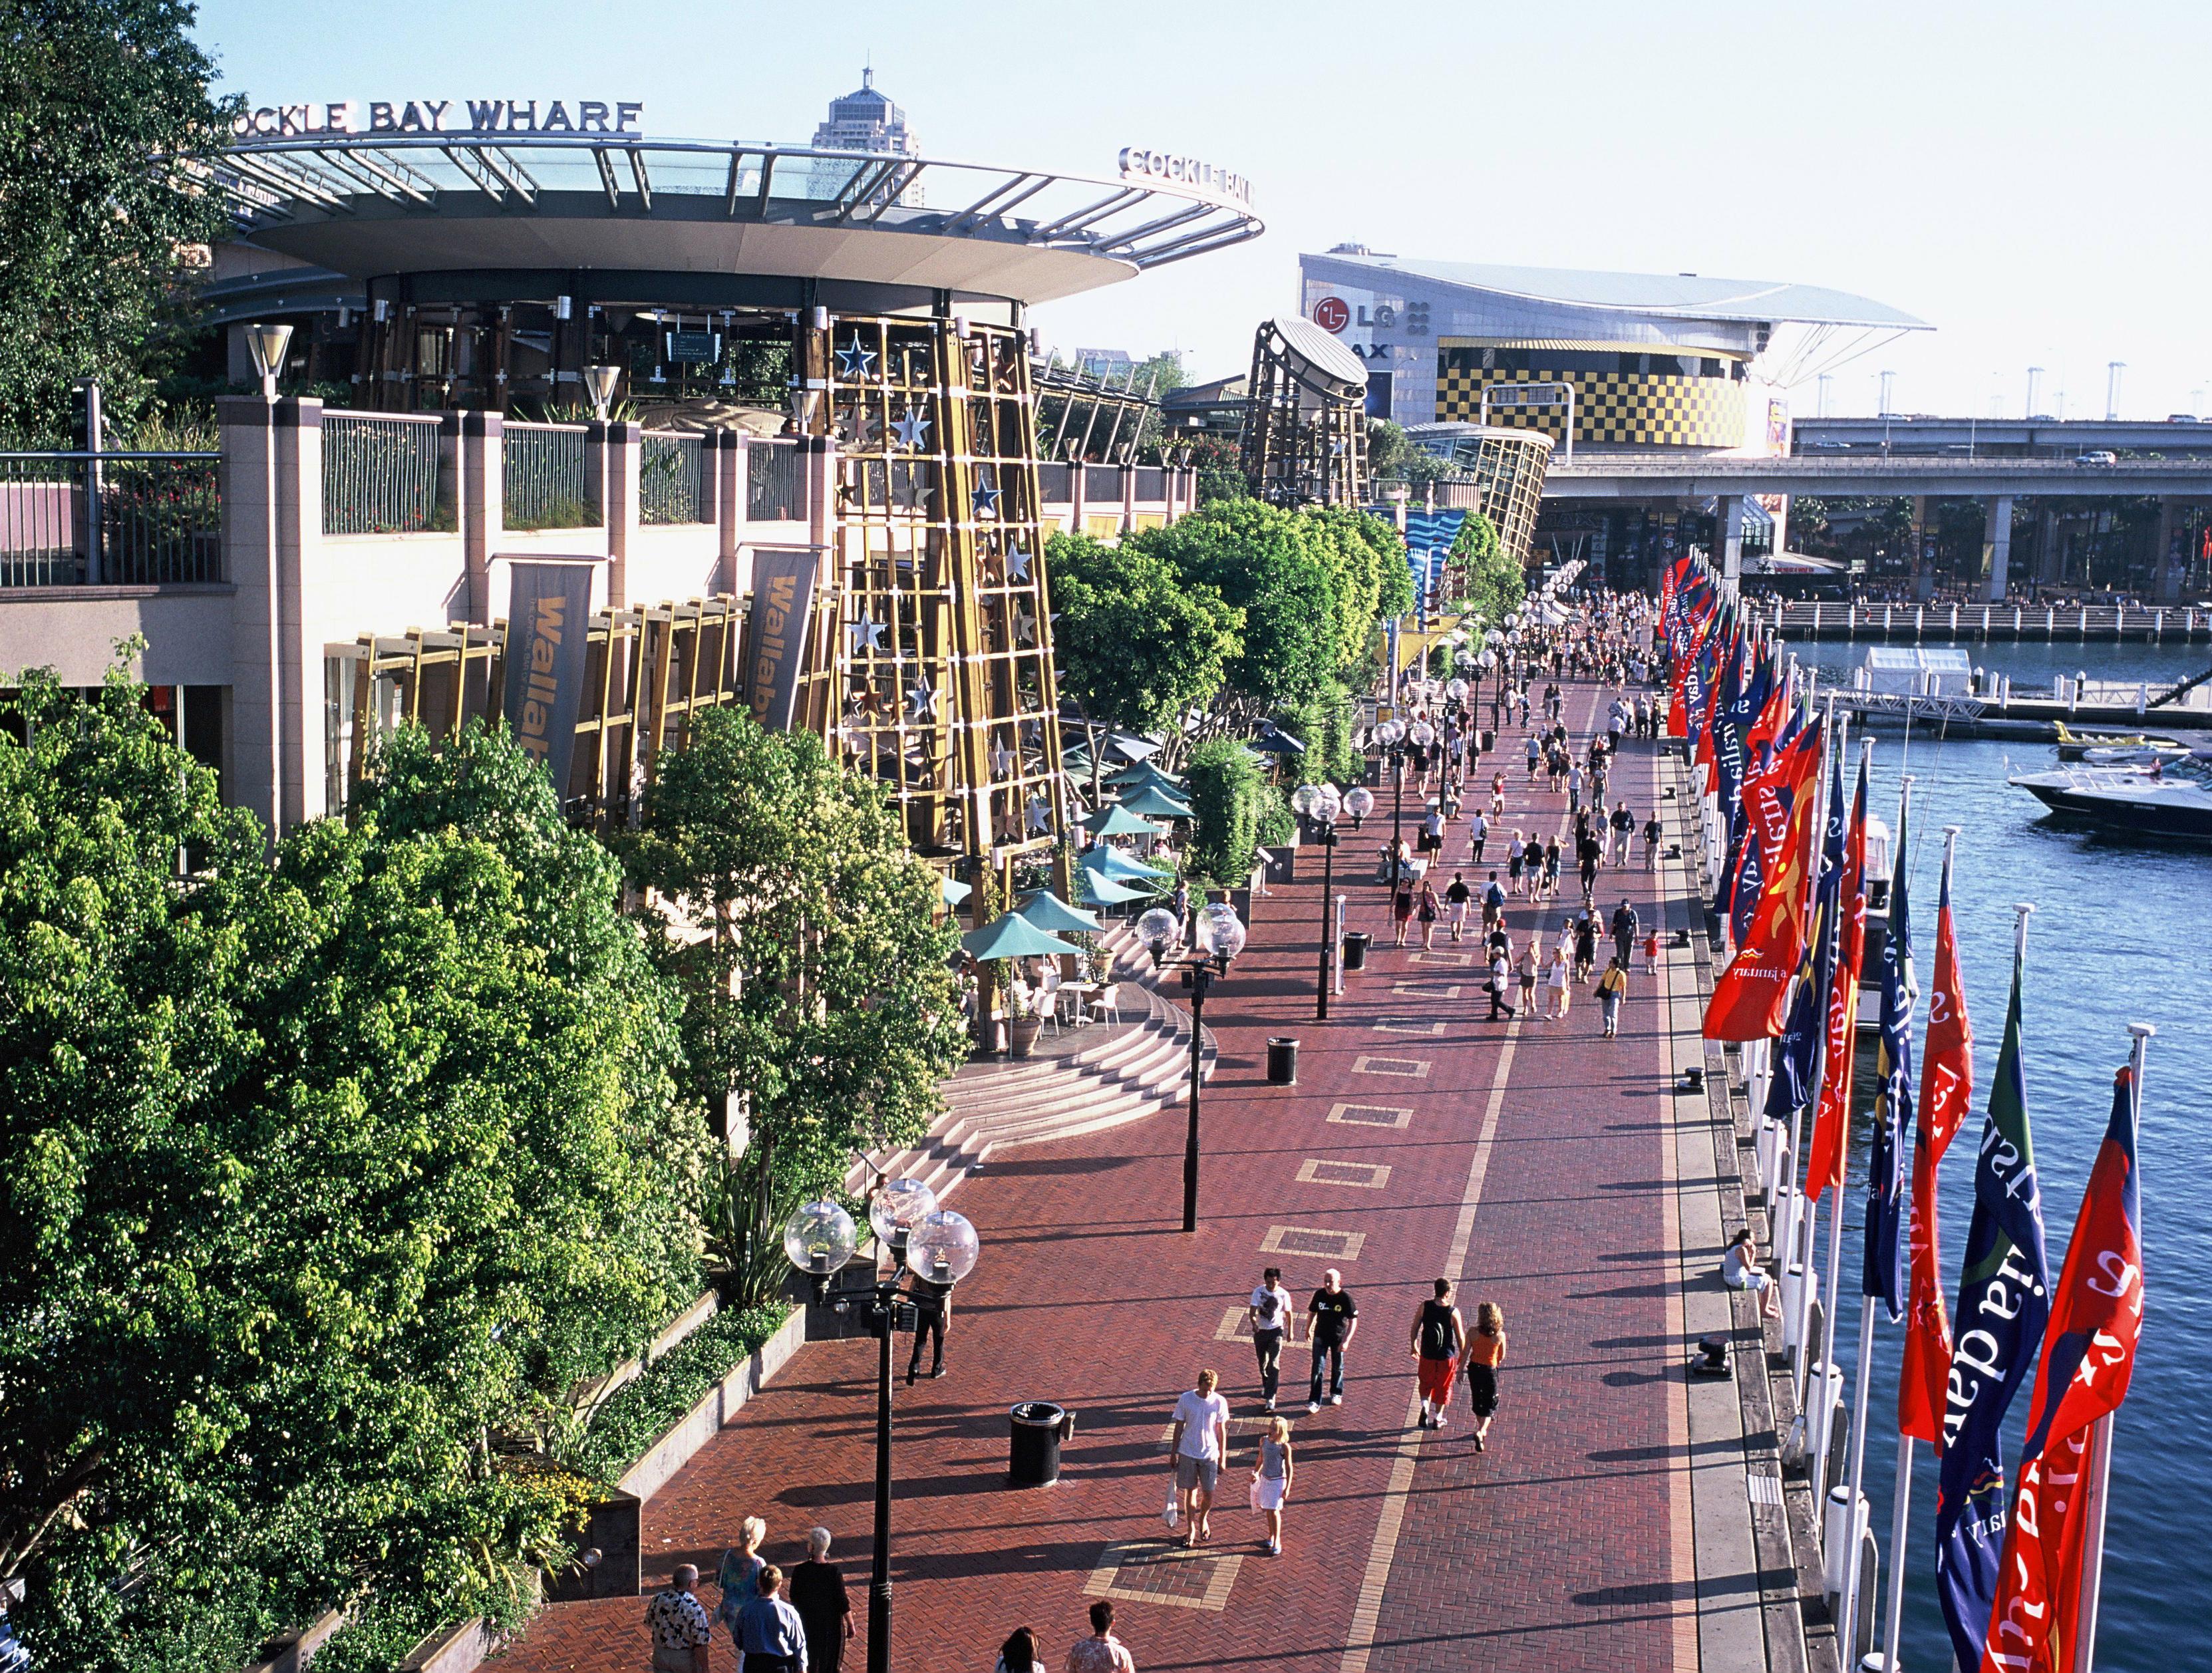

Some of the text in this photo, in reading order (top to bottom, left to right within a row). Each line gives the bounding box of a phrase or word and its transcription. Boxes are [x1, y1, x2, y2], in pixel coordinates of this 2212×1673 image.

[234, 100, 643, 138] OCKLE BAY WHARF
[1118, 147, 1226, 194] COCKLE
[1358, 305, 1394, 327] LG
[1352, 343, 1388, 359] AX
[520, 596, 565, 764] Wallab
